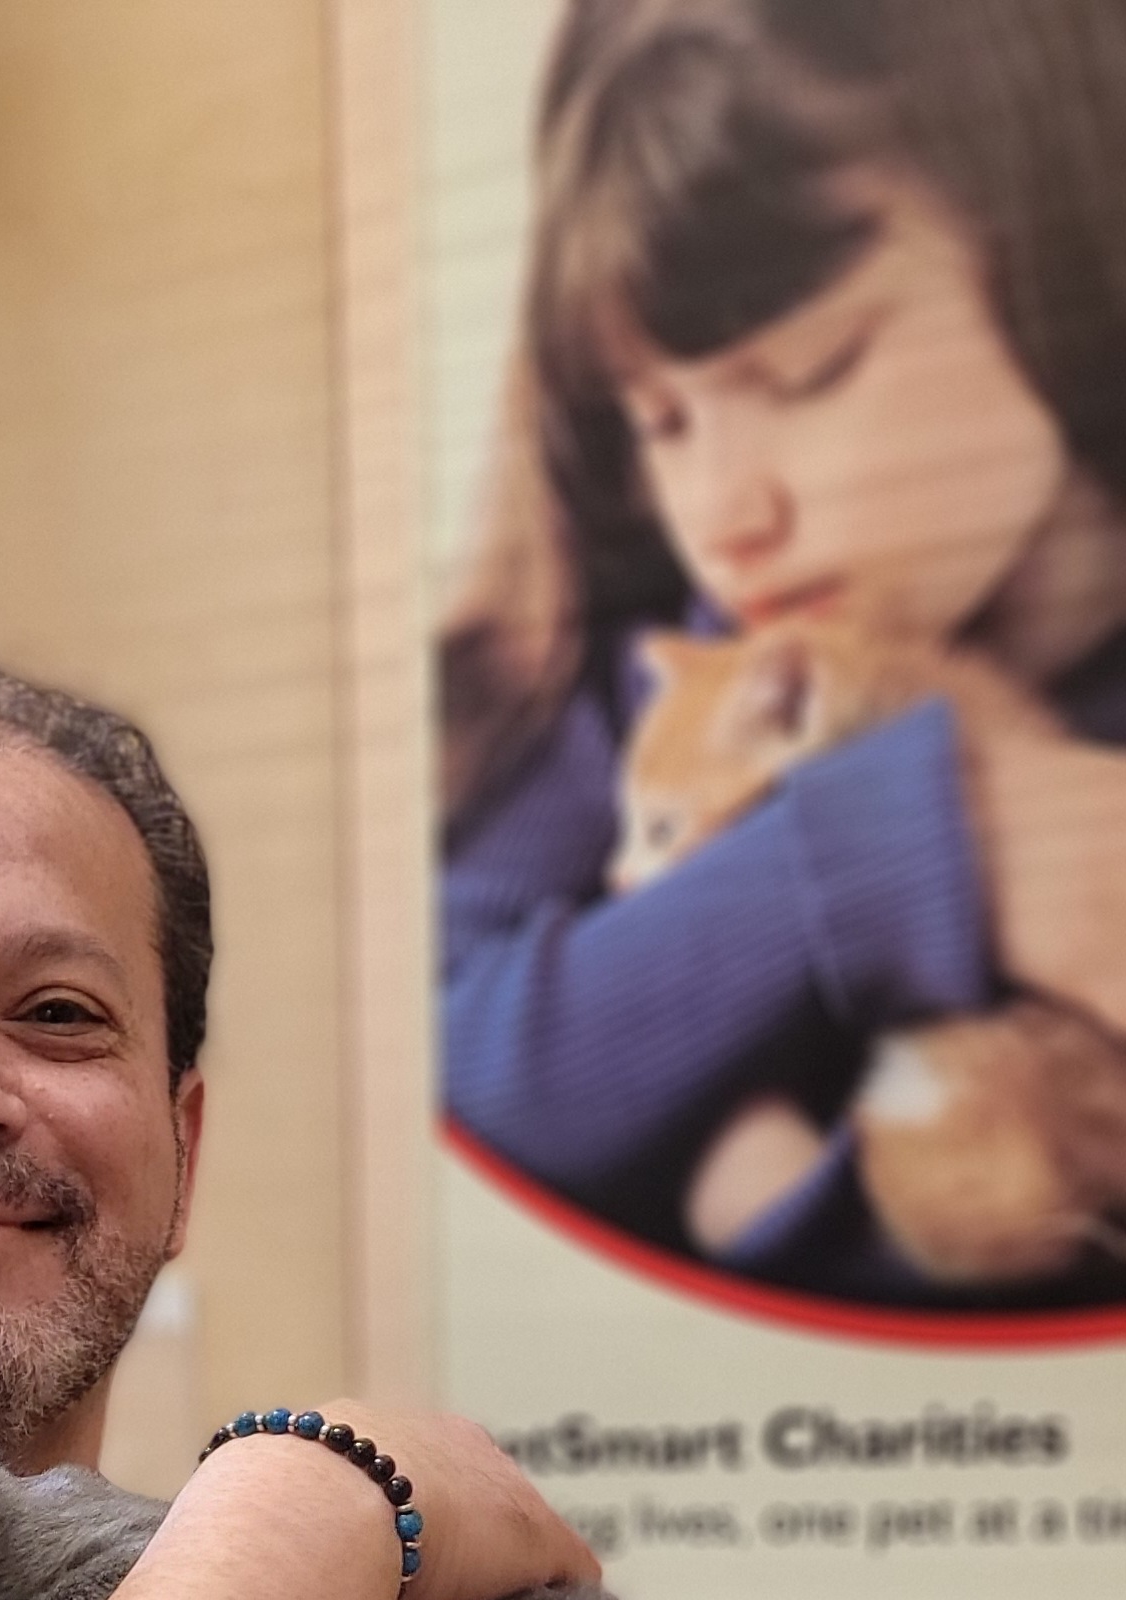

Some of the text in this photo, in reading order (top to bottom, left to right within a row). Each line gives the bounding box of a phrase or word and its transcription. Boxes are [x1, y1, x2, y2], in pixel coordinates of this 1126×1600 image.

[760, 1405, 1070, 1469] Charities
[760, 1502, 858, 1544] one
[866, 1500, 956, 1555] pet
[964, 1500, 1020, 1544] at
[1030, 1502, 1067, 1544] a
[1077, 1492, 1126, 1543] ti
